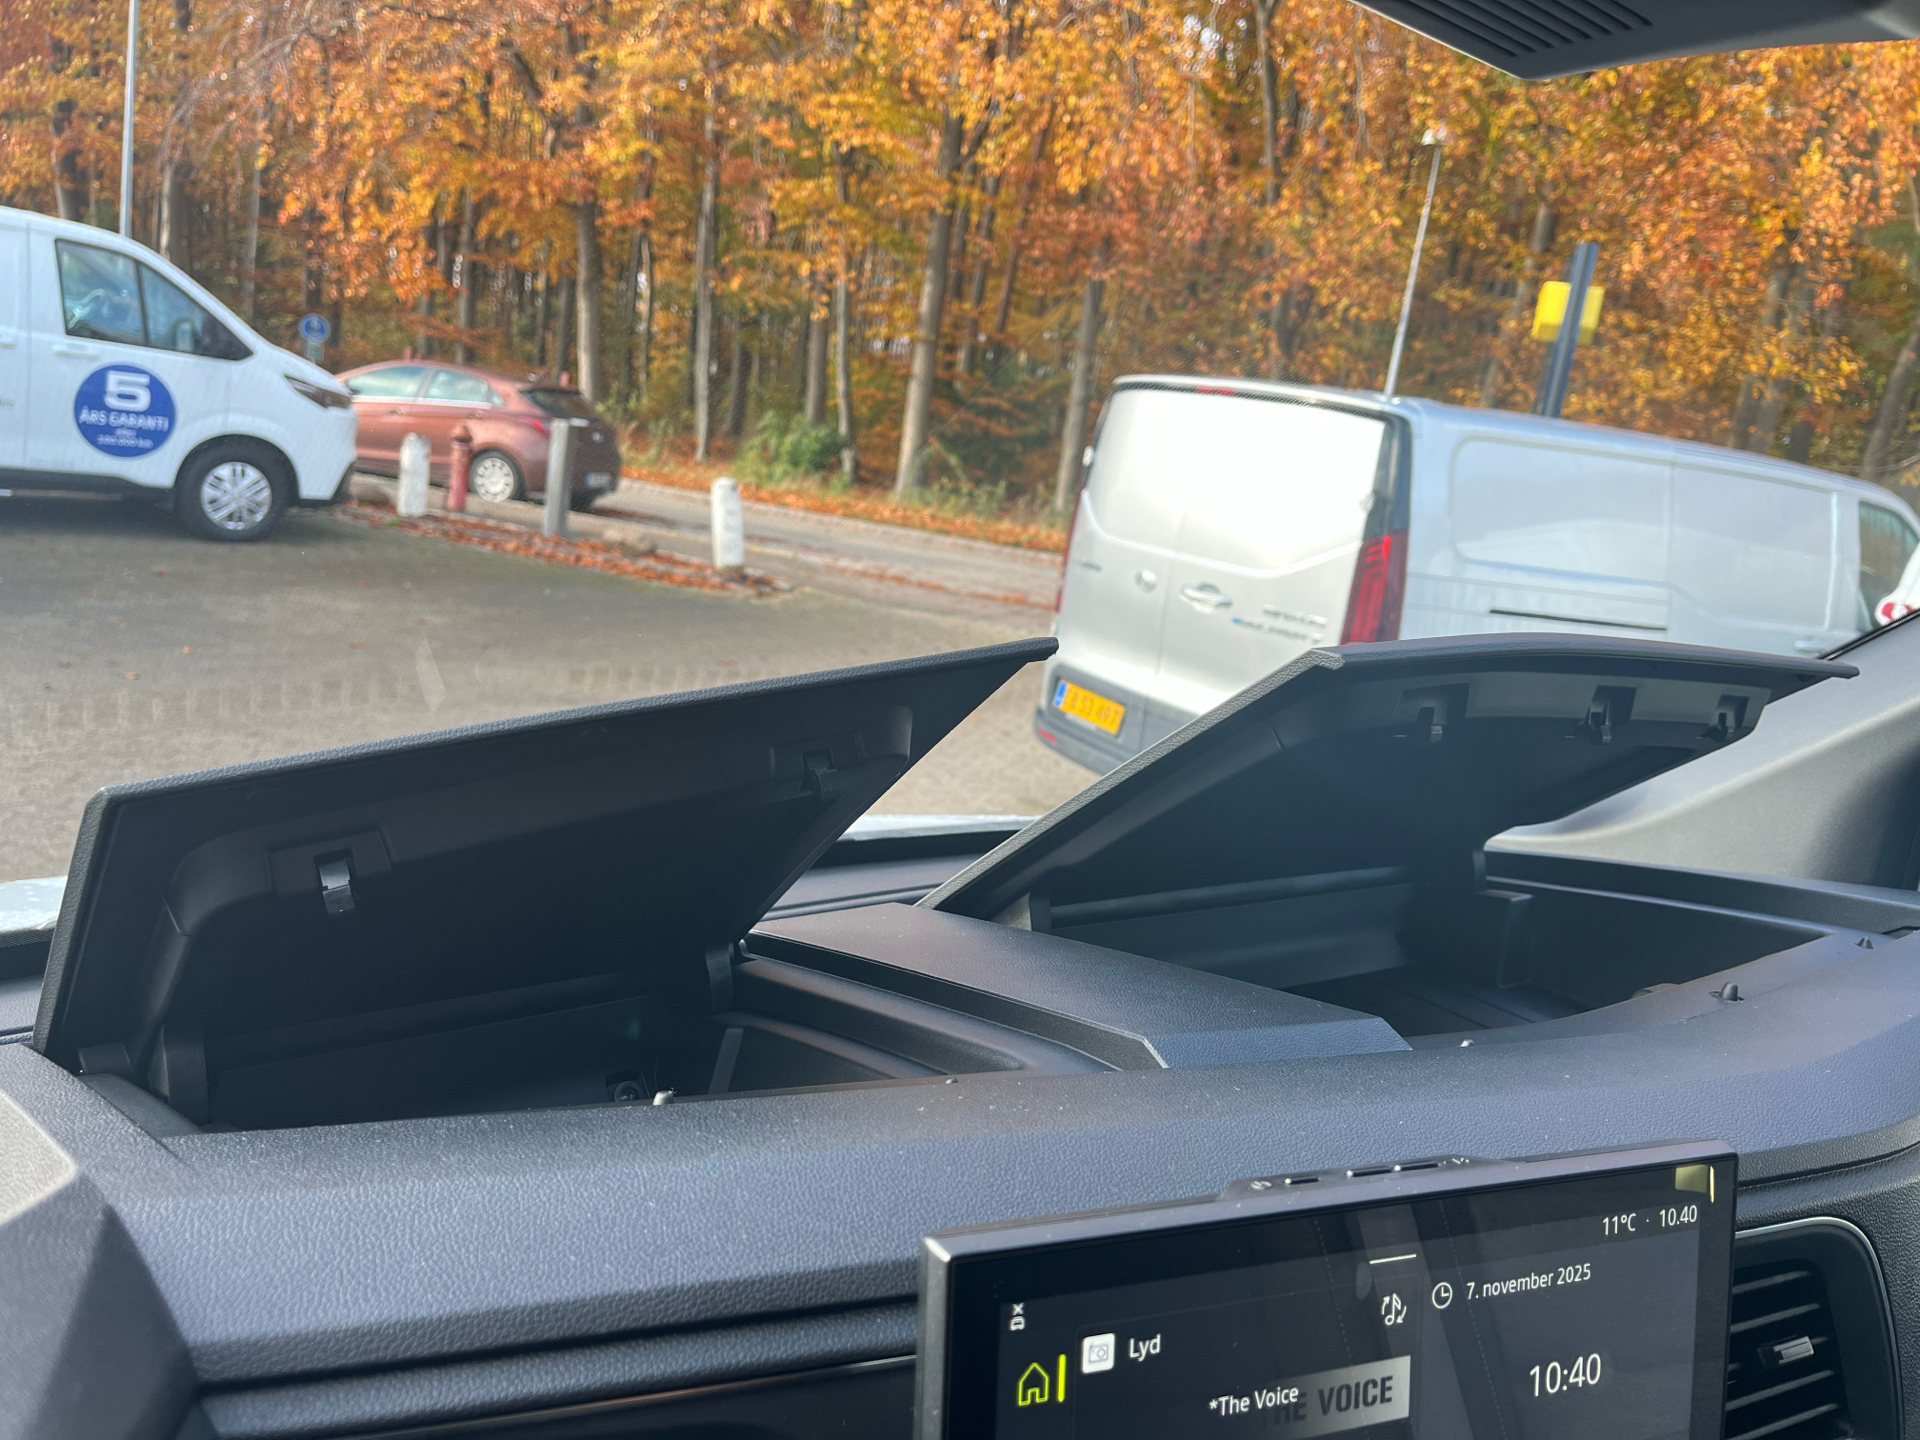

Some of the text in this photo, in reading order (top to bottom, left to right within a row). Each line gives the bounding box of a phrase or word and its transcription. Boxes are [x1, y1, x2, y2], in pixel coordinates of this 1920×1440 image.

[104, 369, 151, 412] 5
[109, 411, 169, 432] GARANTI
[1659, 1204, 1698, 1228] 10.40
[1466, 1263, 1592, 1300] 7. november 2025
[1129, 1333, 1161, 1361] Lyd
[1529, 1353, 1602, 1397] 10:40
[1254, 1386, 1299, 1410] Voice
[1318, 1375, 1394, 1416] VOICE
